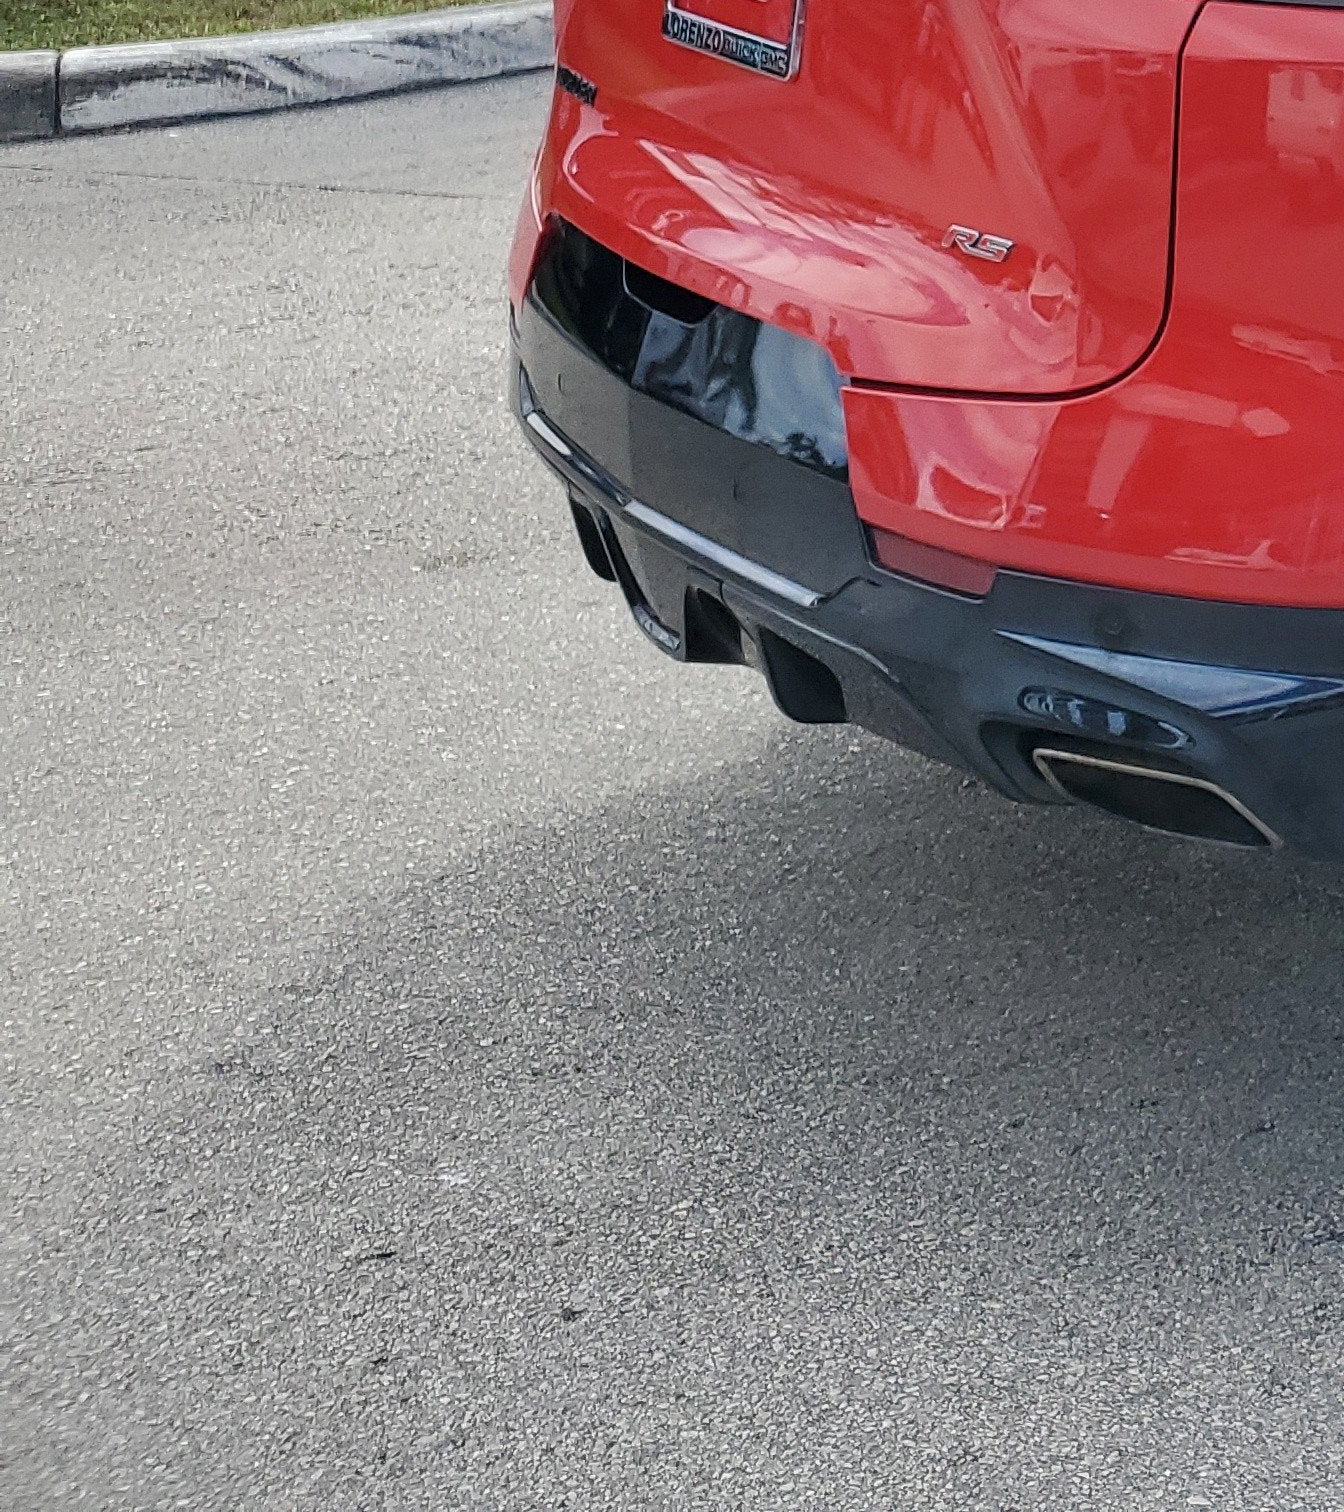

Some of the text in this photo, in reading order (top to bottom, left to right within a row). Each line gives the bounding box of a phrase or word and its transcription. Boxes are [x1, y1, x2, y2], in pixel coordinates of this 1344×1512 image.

[665, 12, 723, 57] LORENZO
[723, 36, 759, 63] BUICK
[941, 222, 1016, 263] RS
